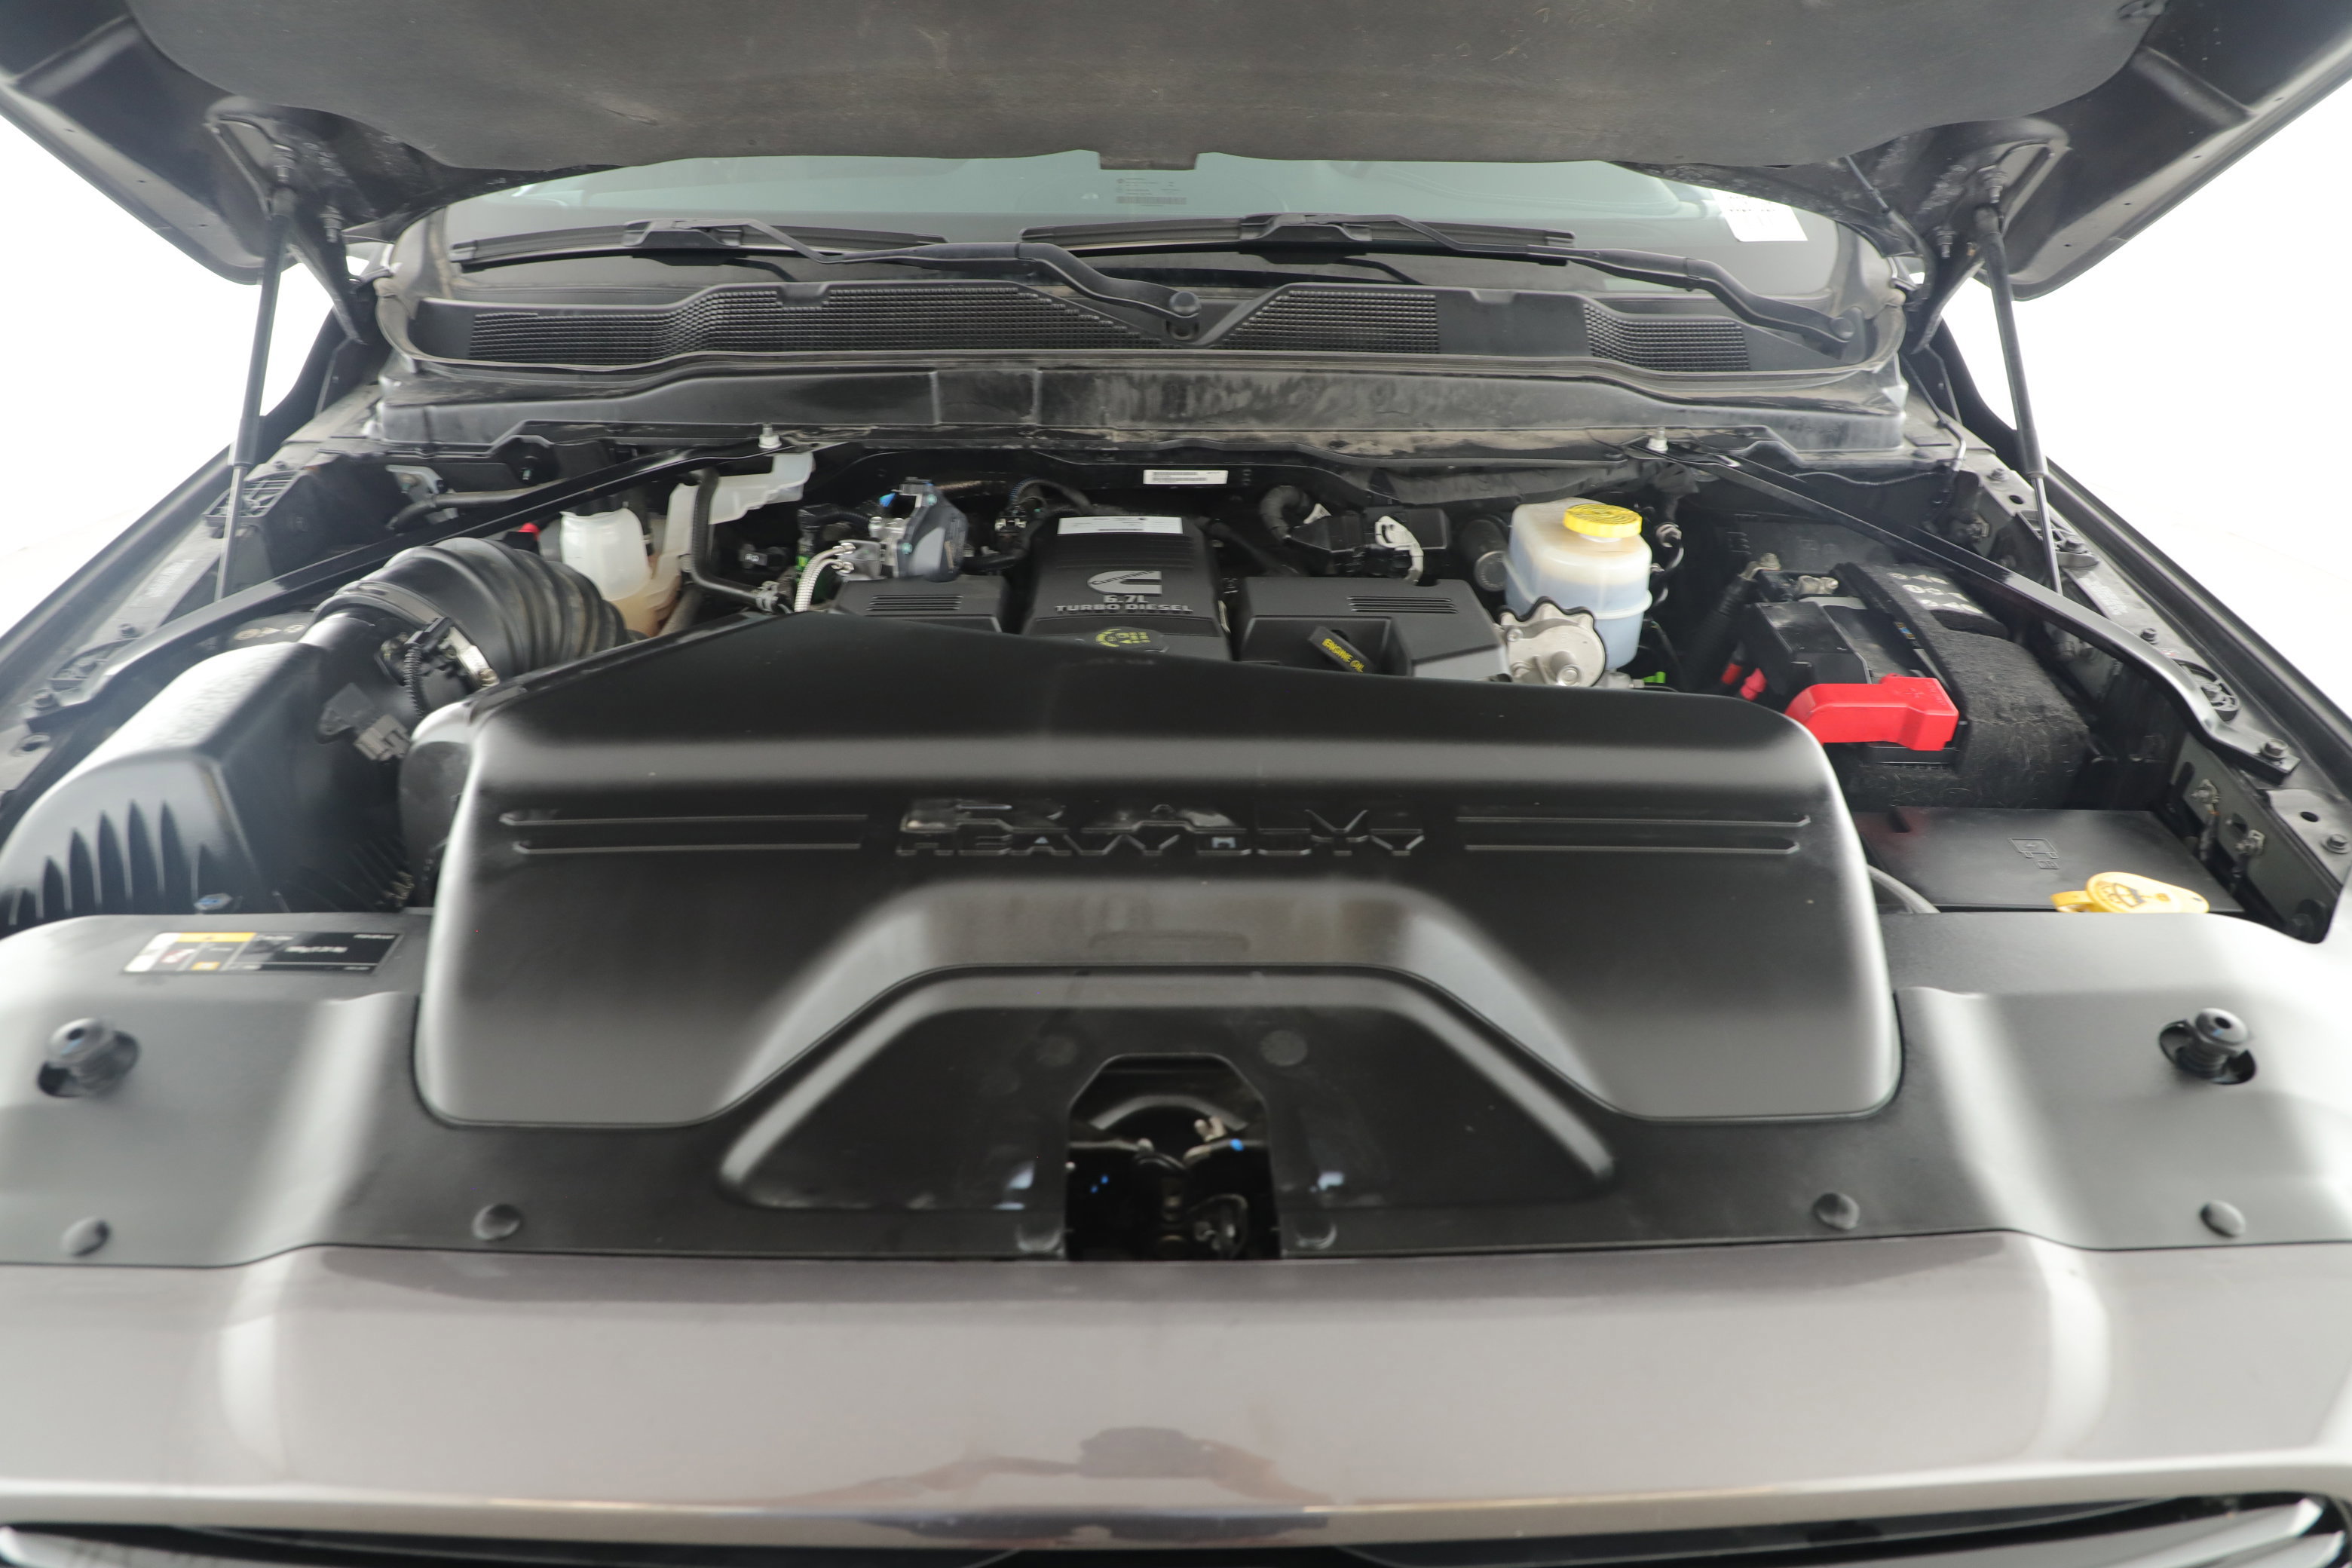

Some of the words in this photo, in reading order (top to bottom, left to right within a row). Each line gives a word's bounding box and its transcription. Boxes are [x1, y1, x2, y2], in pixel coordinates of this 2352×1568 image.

[1092, 570, 1155, 585] Cummins
[1103, 594, 1149, 604] 6.7L
[1055, 604, 1121, 613] TURBO
[1125, 604, 1193, 613] DIESEL
[1321, 638, 1354, 663] ENGINE
[1349, 660, 1364, 673] OIL
[895, 833, 1181, 856] HEAVY
